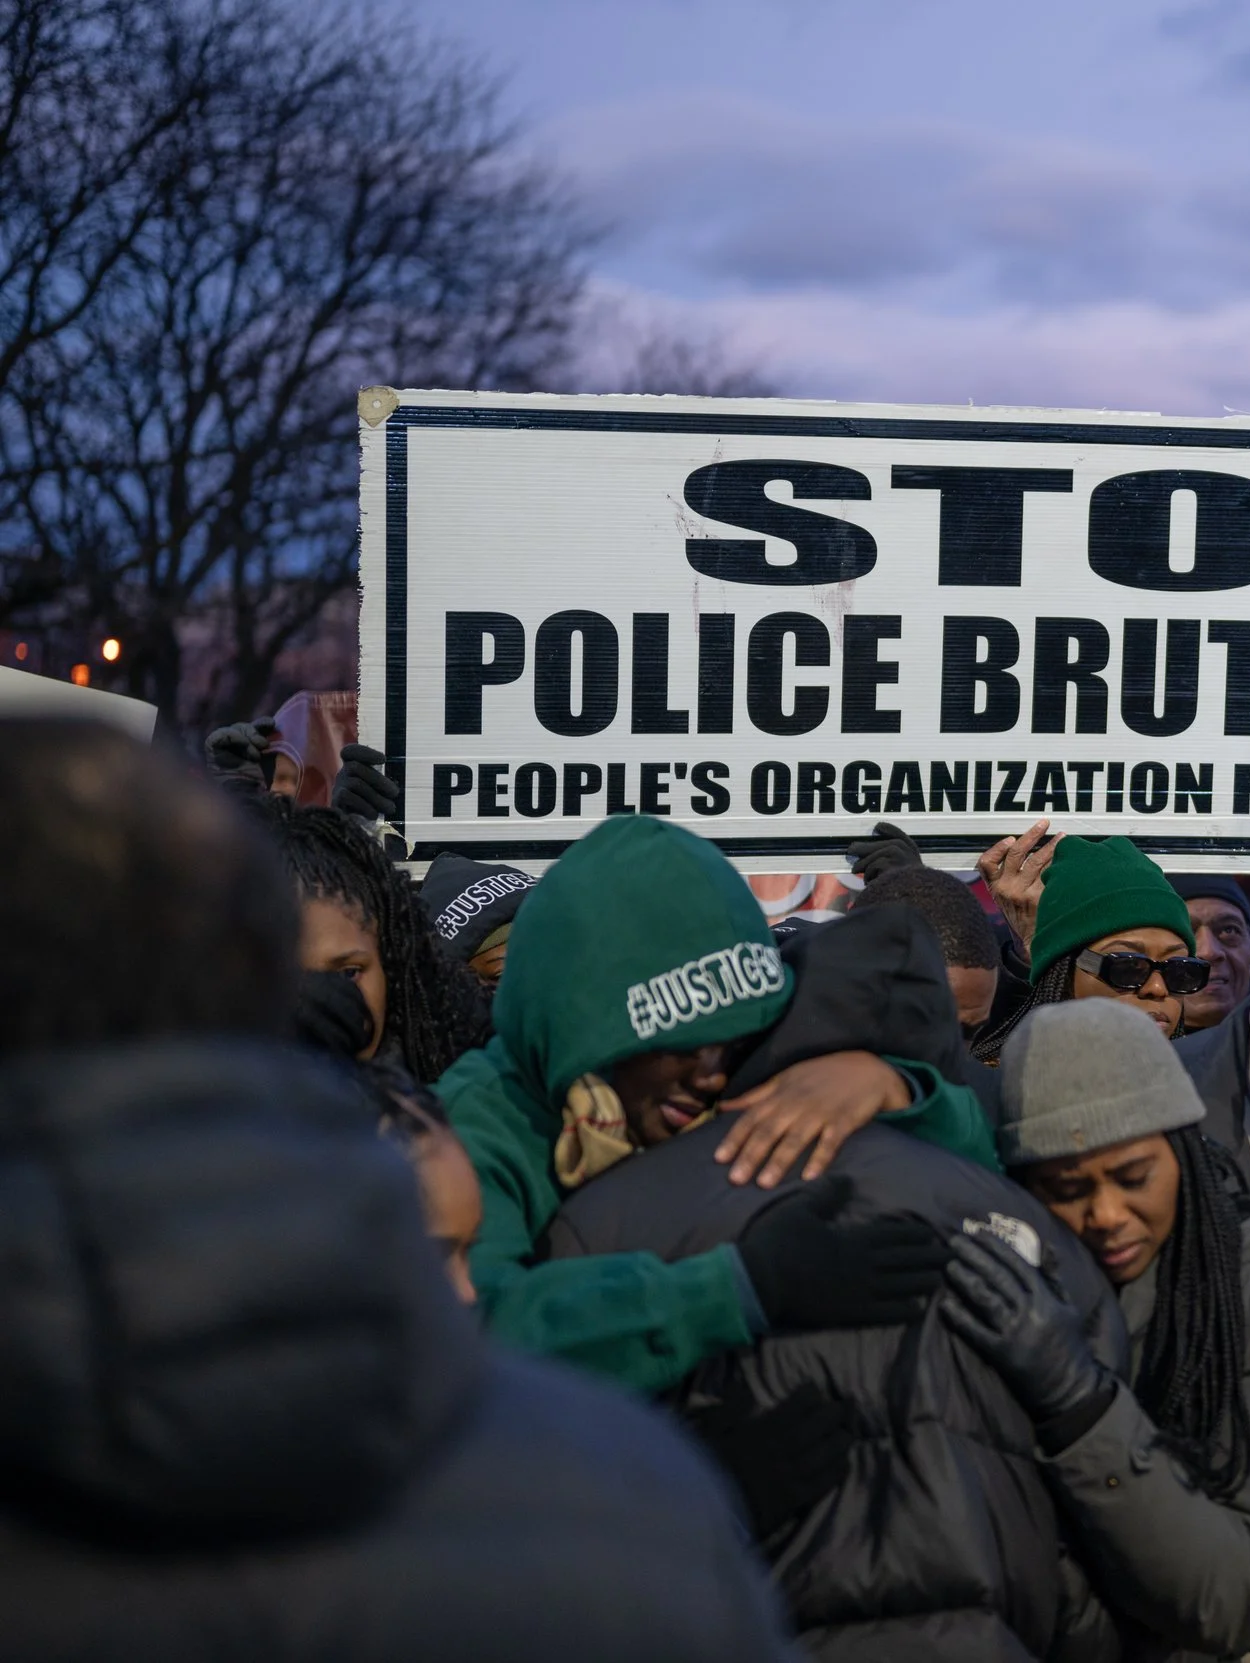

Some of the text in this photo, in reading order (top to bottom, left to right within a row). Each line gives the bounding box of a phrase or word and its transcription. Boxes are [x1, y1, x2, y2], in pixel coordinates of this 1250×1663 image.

[444, 609, 902, 737] POLICE
[432, 760, 731, 818] PEOPLE'S
[750, 760, 1214, 816] ORGANIZATION
